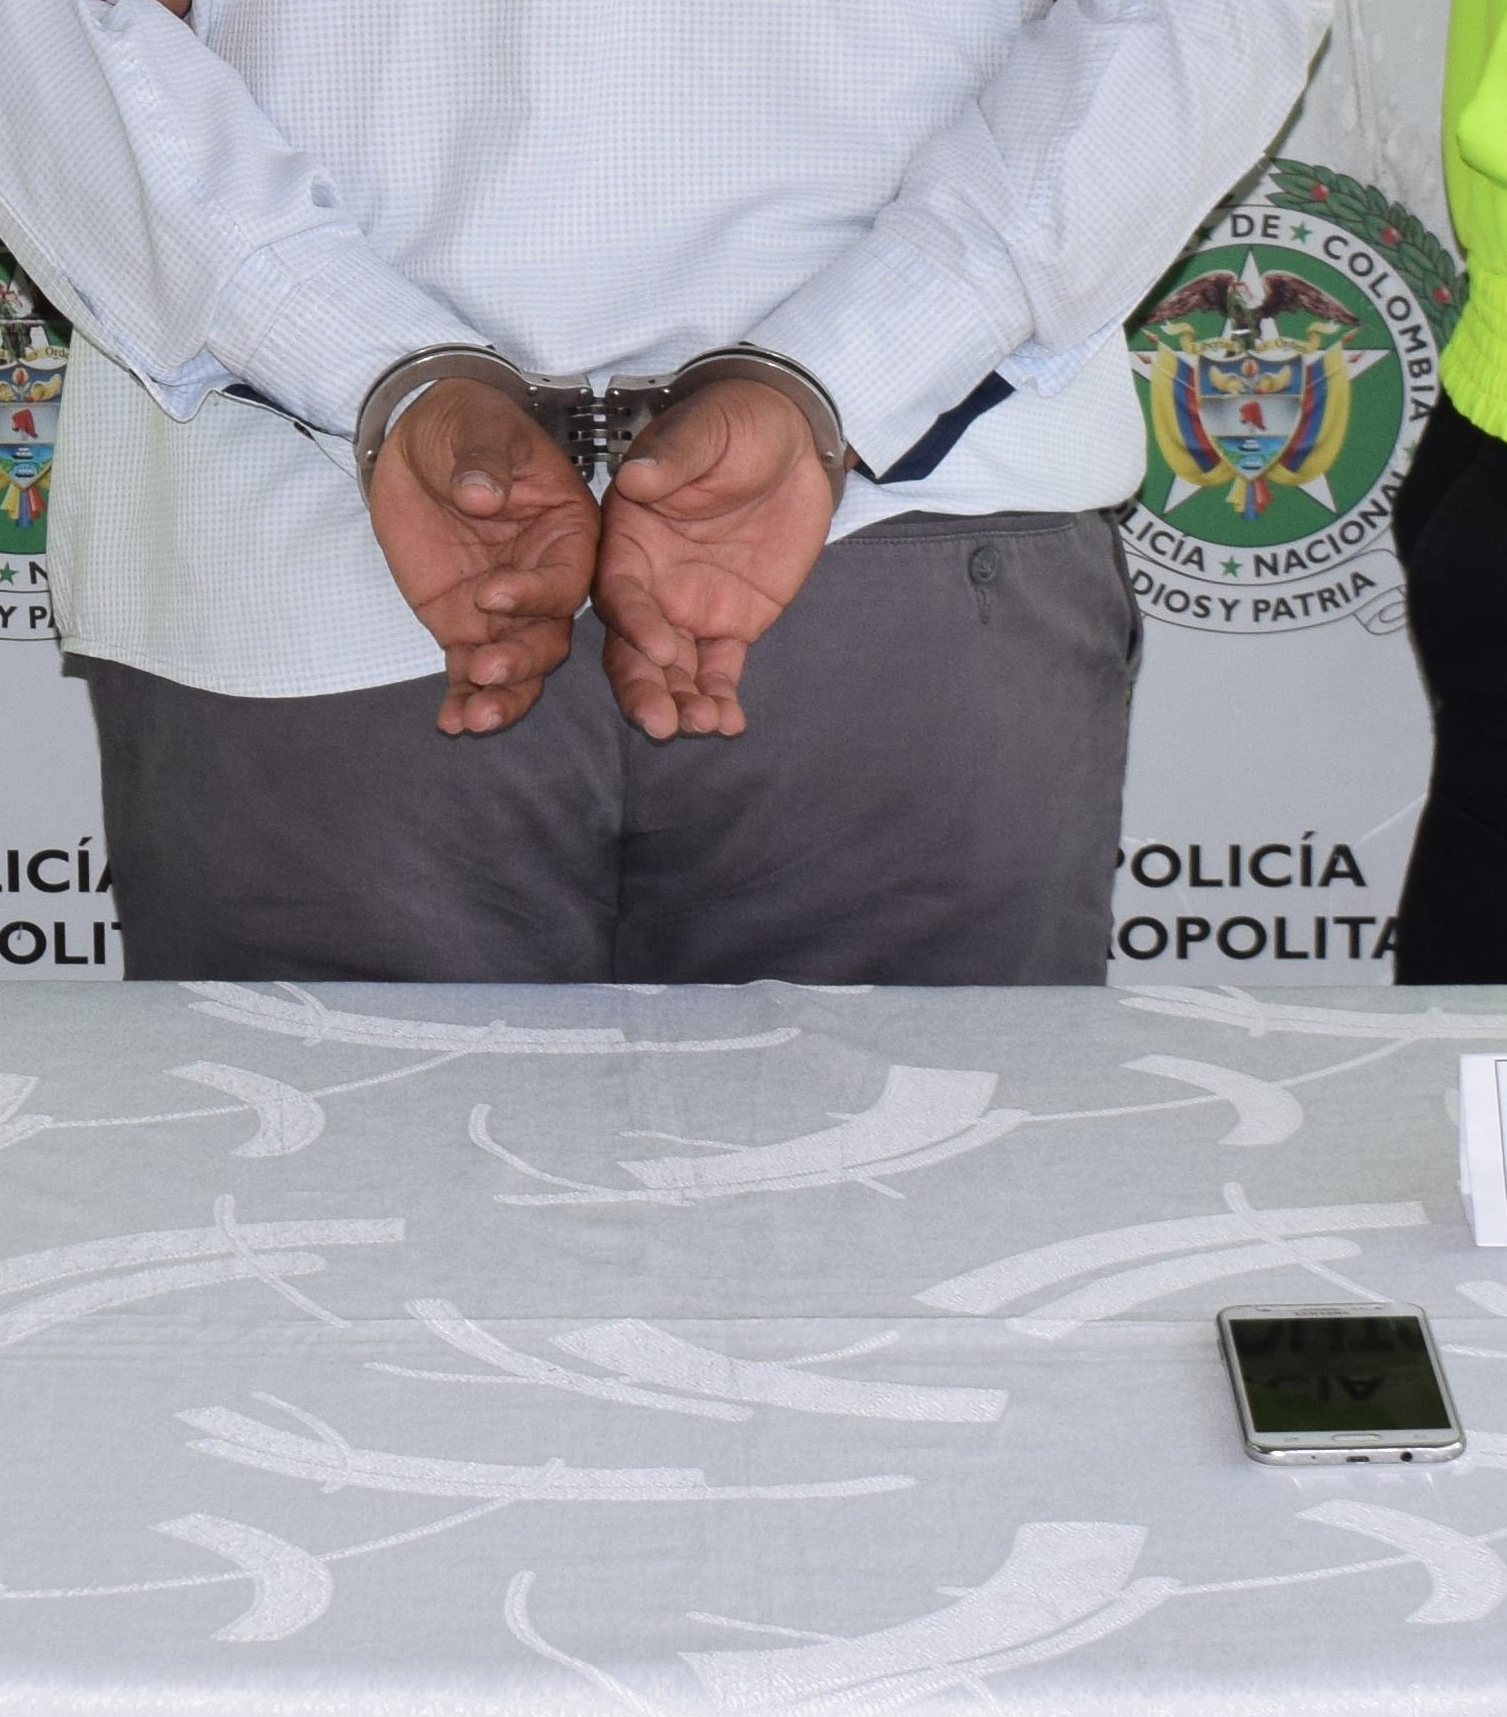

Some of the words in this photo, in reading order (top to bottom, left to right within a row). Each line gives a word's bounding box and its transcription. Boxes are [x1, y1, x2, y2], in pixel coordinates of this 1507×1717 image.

[1232, 214, 1279, 239] DE
[1324, 234, 1439, 421] COLOMBIA
[1130, 569, 1213, 621] DIOS
[1253, 570, 1376, 623] PATRIA
[1117, 832, 1367, 888] OLICÍA
